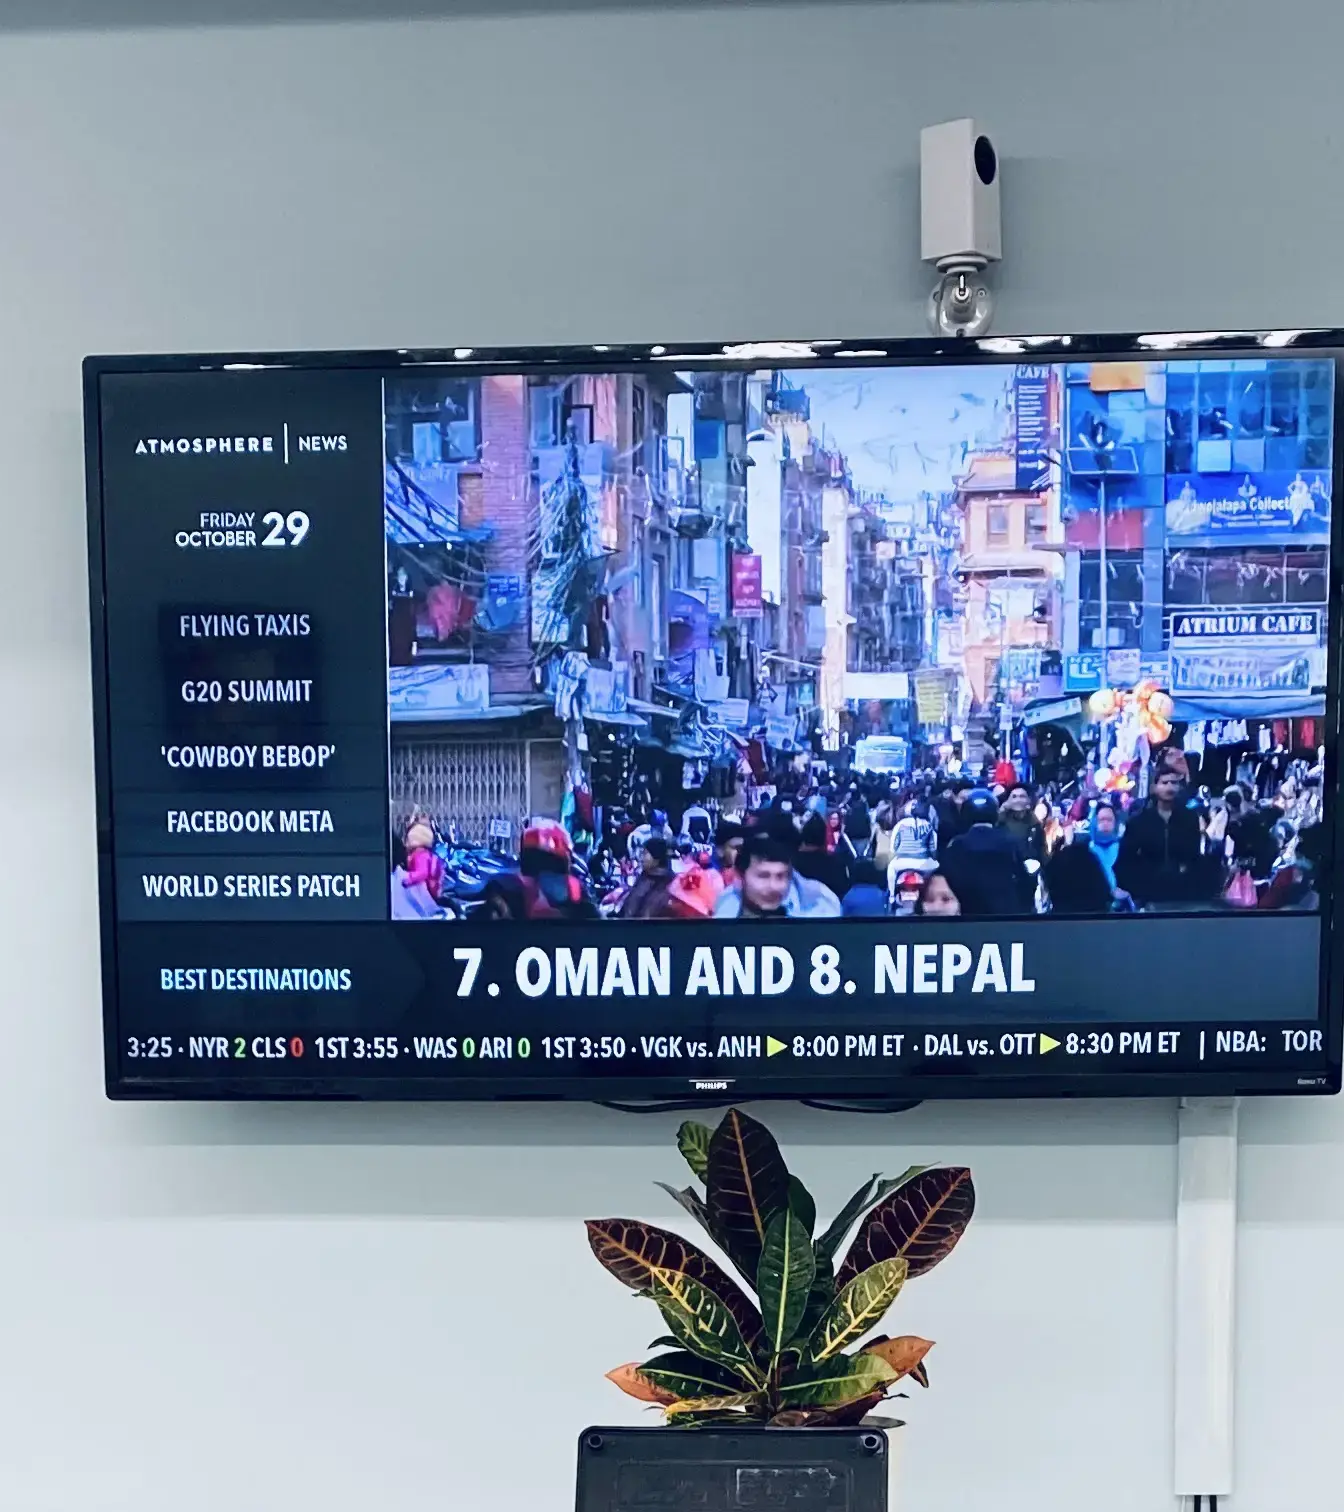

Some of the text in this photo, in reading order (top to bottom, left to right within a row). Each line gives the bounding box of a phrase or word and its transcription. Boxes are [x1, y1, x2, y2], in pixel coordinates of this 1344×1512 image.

[135, 435, 348, 455] ATMOSPHERE NEWS
[175, 531, 257, 548] OCTOBER
[200, 510, 311, 547] FRIDAY 29
[179, 614, 311, 637] FLYING TAXIS
[1177, 614, 1314, 635] ATRIUM CAFE
[181, 679, 313, 702] G20 SUMMIT
[161, 744, 258, 768] 'COWBOY
[166, 809, 335, 833] FACEBOOK META
[142, 875, 361, 897] WORLD SERIES PATCH
[160, 968, 353, 991] BEST DESTINATIONS
[453, 942, 1036, 998] 7. OMAN AND 8. NEPAL
[127, 1029, 1323, 1059] 3:25 NYR 2 CLS 0 1ST 3:55 WAS 0 ARI 0 1ST 3:50 VGK vs. ANH 8:00 PM ET DAL vs. OTT 8:30 PM ET NBA: TOR
[695, 1082, 728, 1090] PHILIPS
